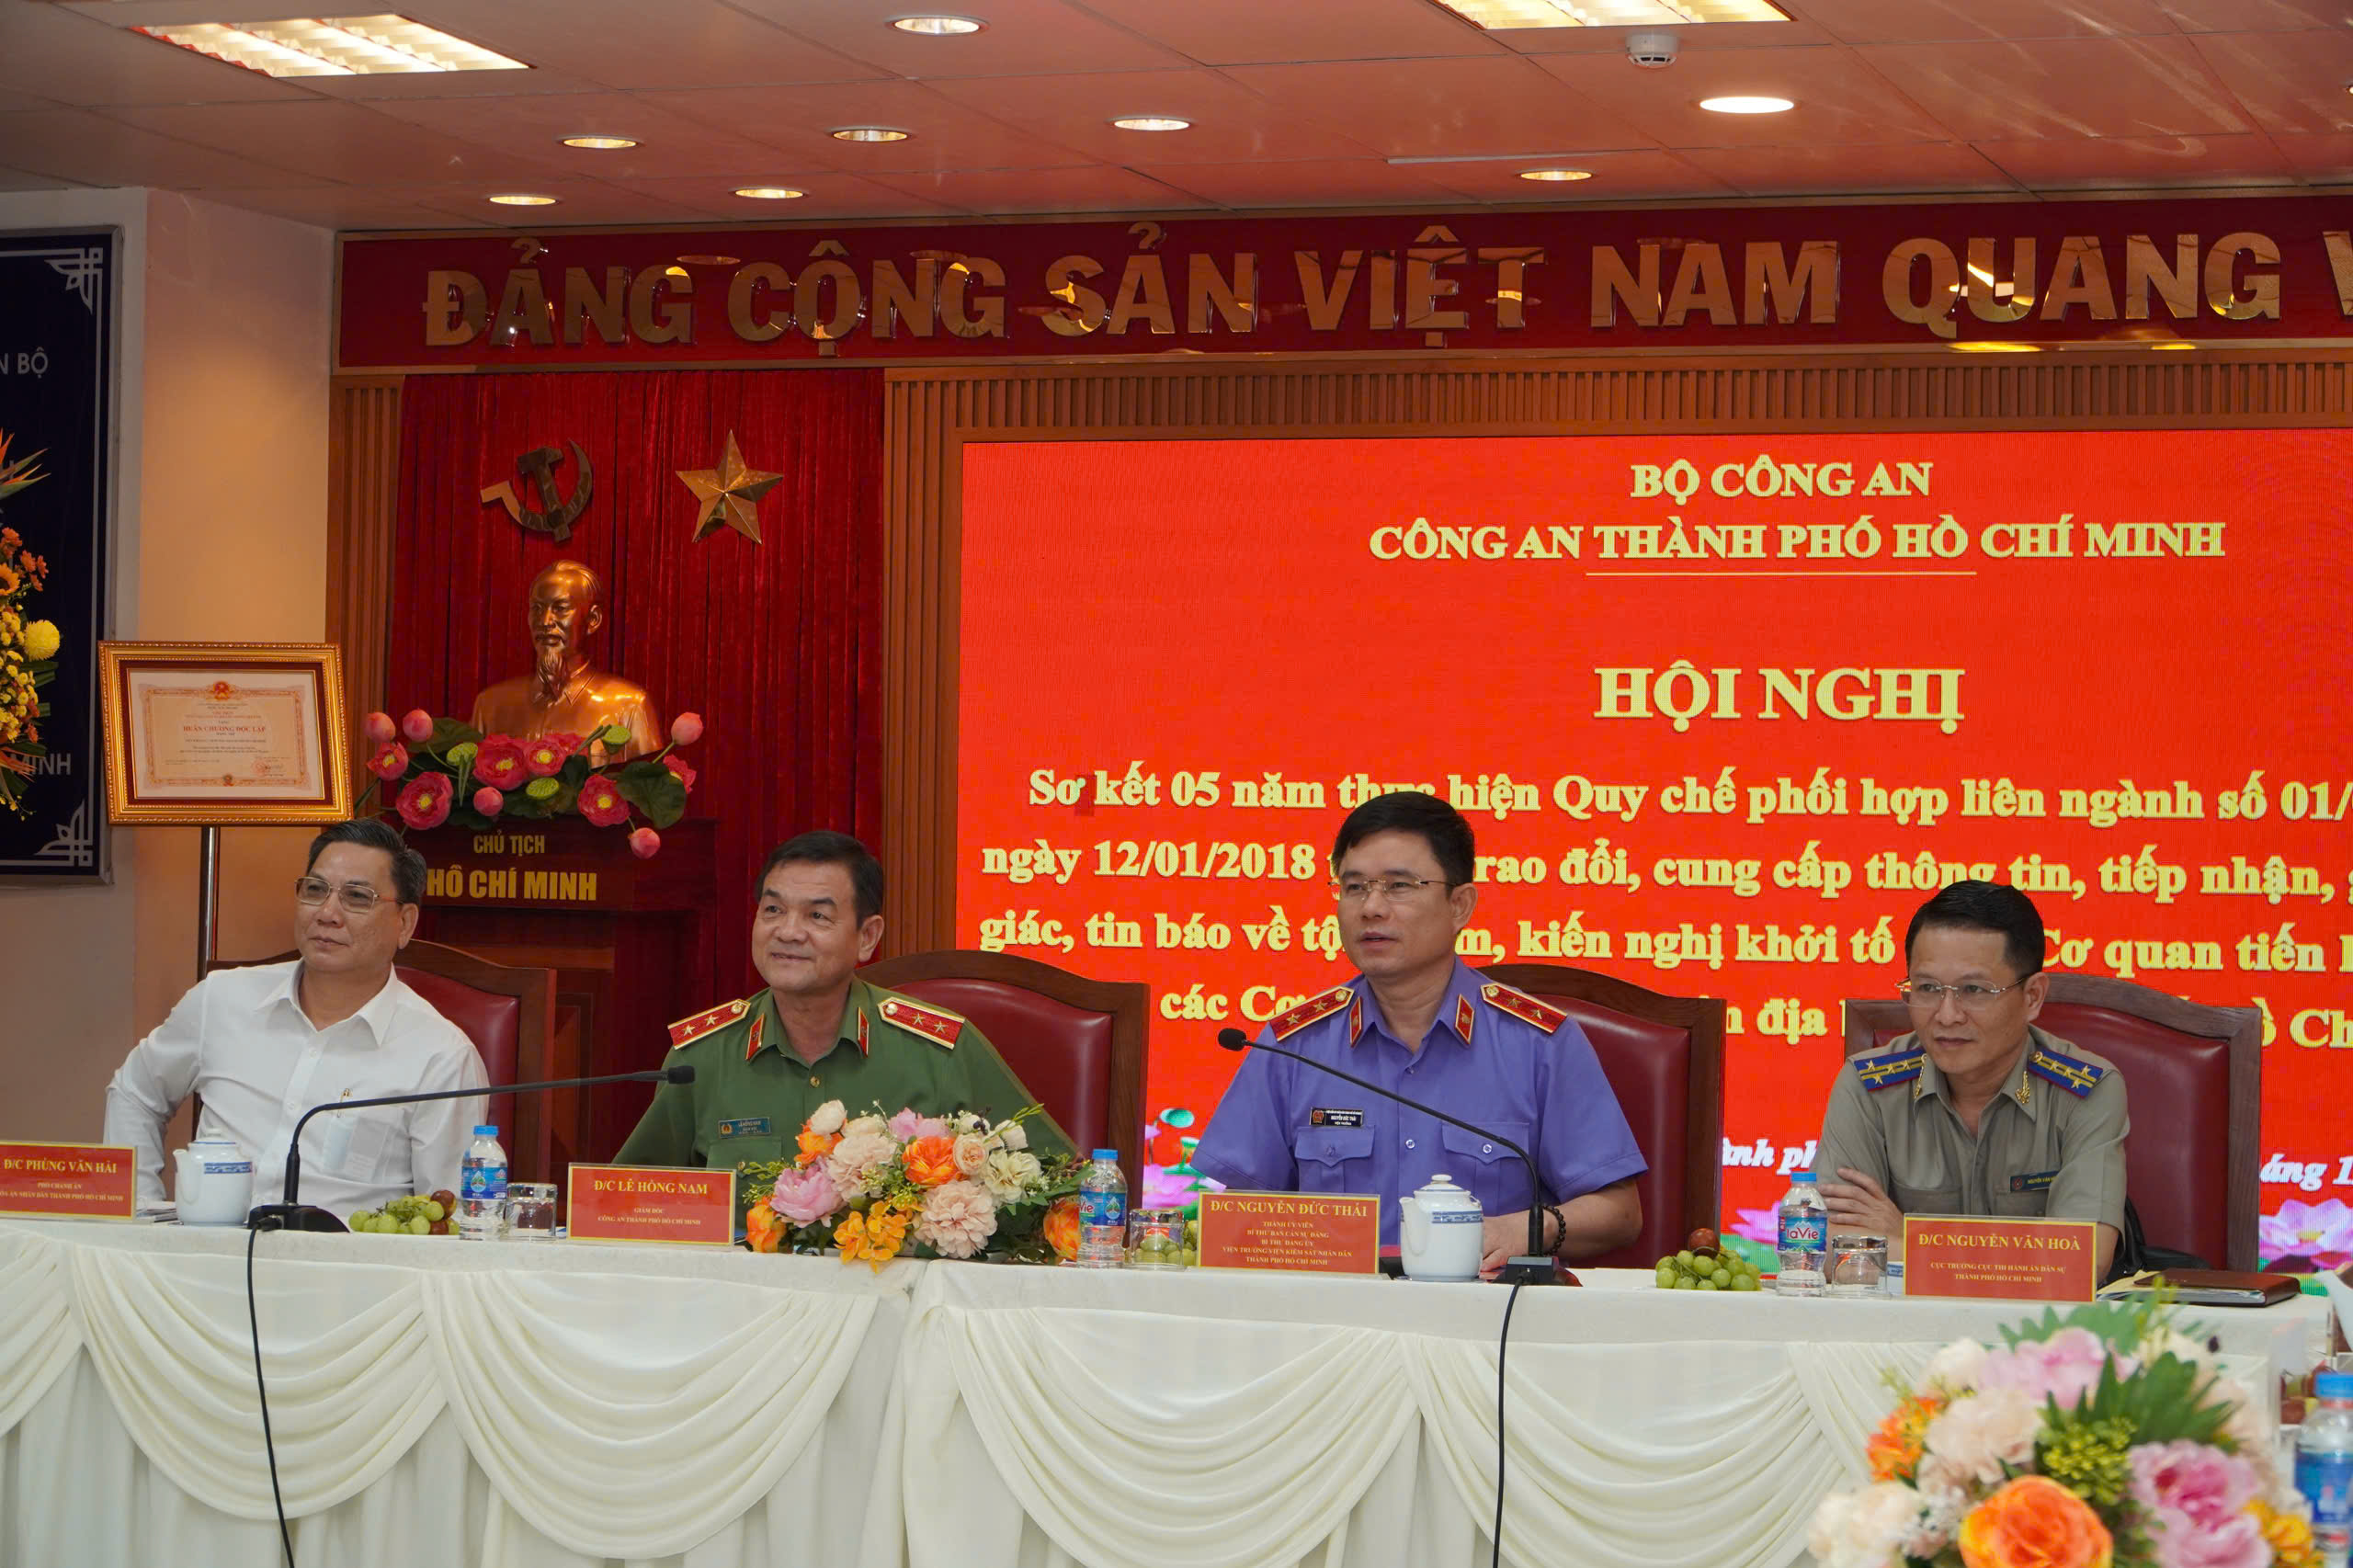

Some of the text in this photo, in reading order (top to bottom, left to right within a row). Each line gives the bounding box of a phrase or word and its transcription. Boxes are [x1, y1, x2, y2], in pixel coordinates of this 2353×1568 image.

[423, 236, 695, 346] ĐẢNG
[727, 240, 1009, 358] CỘNG
[1041, 221, 1257, 337] SẢN
[1293, 225, 1545, 348] VIỆT
[1590, 238, 1838, 327] NAM
[1881, 232, 2282, 339] QUANG
[17, 347, 49, 379] BỘ
[1631, 455, 1933, 506] BỘ CÔNG AN
[1370, 514, 2225, 559] CÔNG AN THÀNH PHỐ HỒ CHÍ MINH
[1594, 660, 1965, 733] HỘI NGHỊ
[1029, 770, 1086, 805] Sơ
[1095, 761, 1161, 805] kết
[1171, 772, 1220, 806] 05
[1232, 772, 1326, 807] năm
[1448, 774, 1540, 820] hiện
[1553, 776, 1649, 822] Quy
[1660, 770, 1735, 813] chế
[1747, 767, 1848, 824] phối
[1860, 778, 1949, 825] hợp
[1961, 778, 2046, 816] liên
[2059, 779, 2204, 827] ngành
[2218, 771, 2267, 819] số
[473, 829, 545, 857] CHỦ TỊCH
[426, 864, 597, 901] HỒ CHÍ MINH
[983, 839, 1082, 884] ngày
[1095, 841, 1315, 879] 12/01/2018
[1474, 857, 1546, 883] rao
[1559, 838, 1641, 890] đổi,
[1654, 858, 1761, 896] cung
[1773, 840, 1851, 898] cấp
[2008, 854, 2086, 900] tin,
[2098, 845, 2187, 903] tiếp
[2200, 856, 2335, 904] nhận,
[980, 910, 1074, 953] giác,
[1086, 912, 1142, 947] tin
[1156, 913, 1224, 949] báo
[1245, 905, 1290, 950] về
[1302, 915, 1338, 960] tộ
[1518, 919, 1612, 958] kiến
[1625, 924, 1724, 969] nghị
[1735, 925, 1838, 962] khởi
[1850, 916, 1895, 963] tố
[2104, 941, 2223, 978] quan
[2236, 923, 2325, 971] tiến
[1161, 983, 1228, 1020] các
[1757, 998, 1827, 1044] địa
[4, 1158, 23, 1169] Đ/C
[595, 1178, 708, 1195] Đ/C LÊ HỒNG NAM
[1211, 1200, 1368, 1217] Đ/C NGUYỄN ĐỨC THÁI
[1918, 1233, 2081, 1250] Đ/C NGUYỄN VĂN HOÀ
